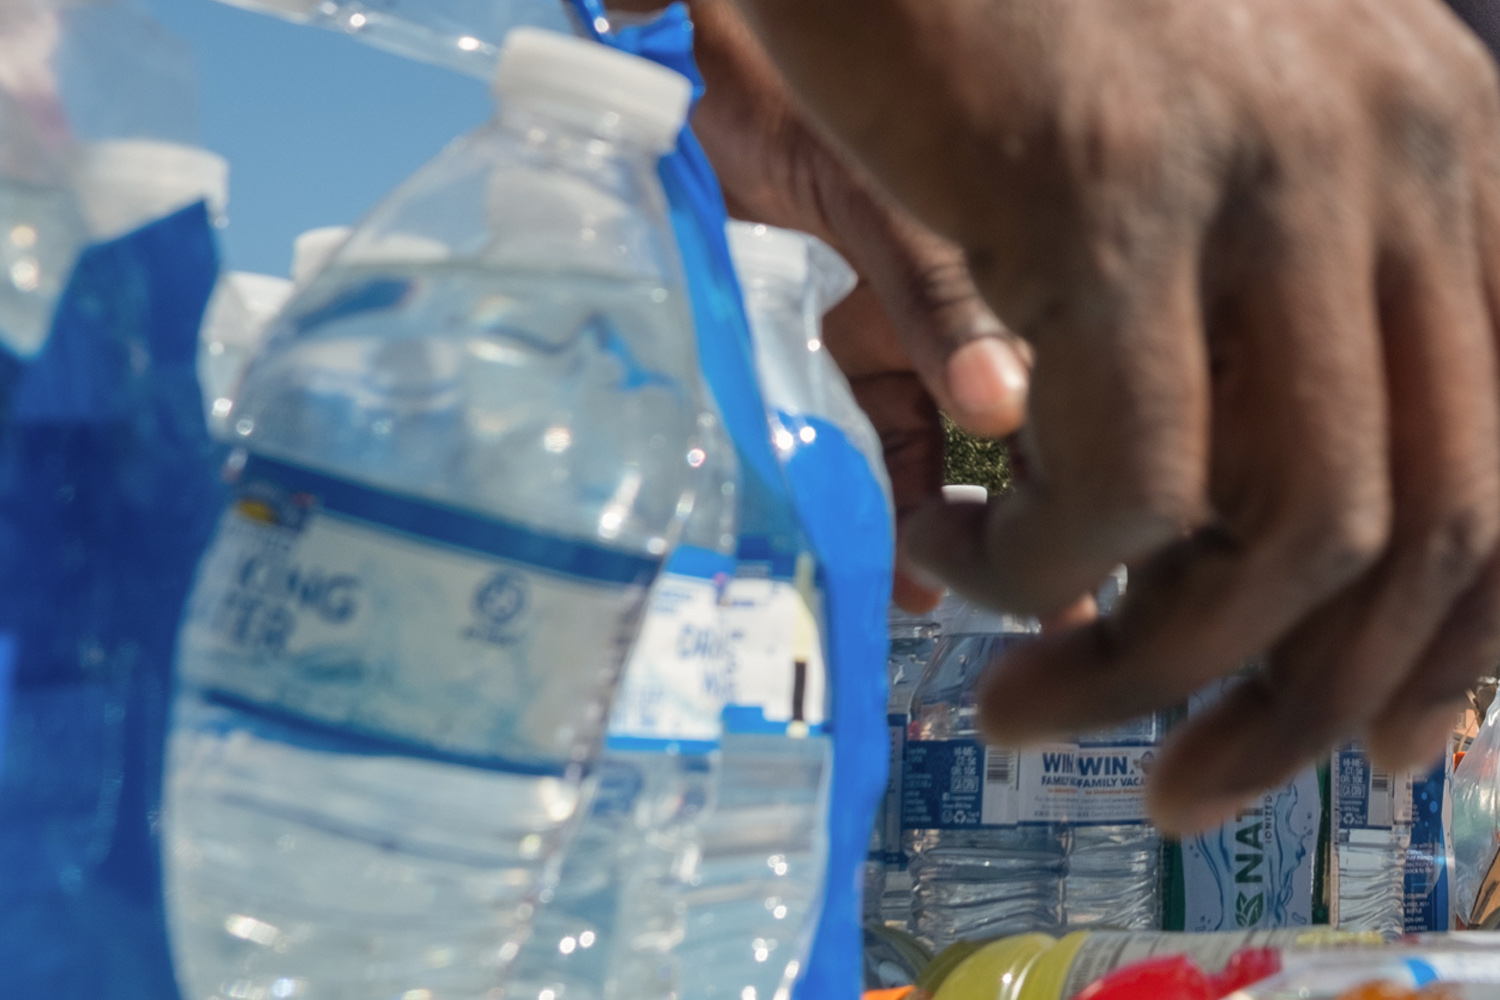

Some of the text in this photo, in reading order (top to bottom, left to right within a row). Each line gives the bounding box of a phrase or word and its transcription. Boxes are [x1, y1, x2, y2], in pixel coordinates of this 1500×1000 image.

[1077, 756, 1128, 776] WIN
[1077, 778, 1118, 788] FAMILY
[1264, 795, 1273, 844] IONIZED
